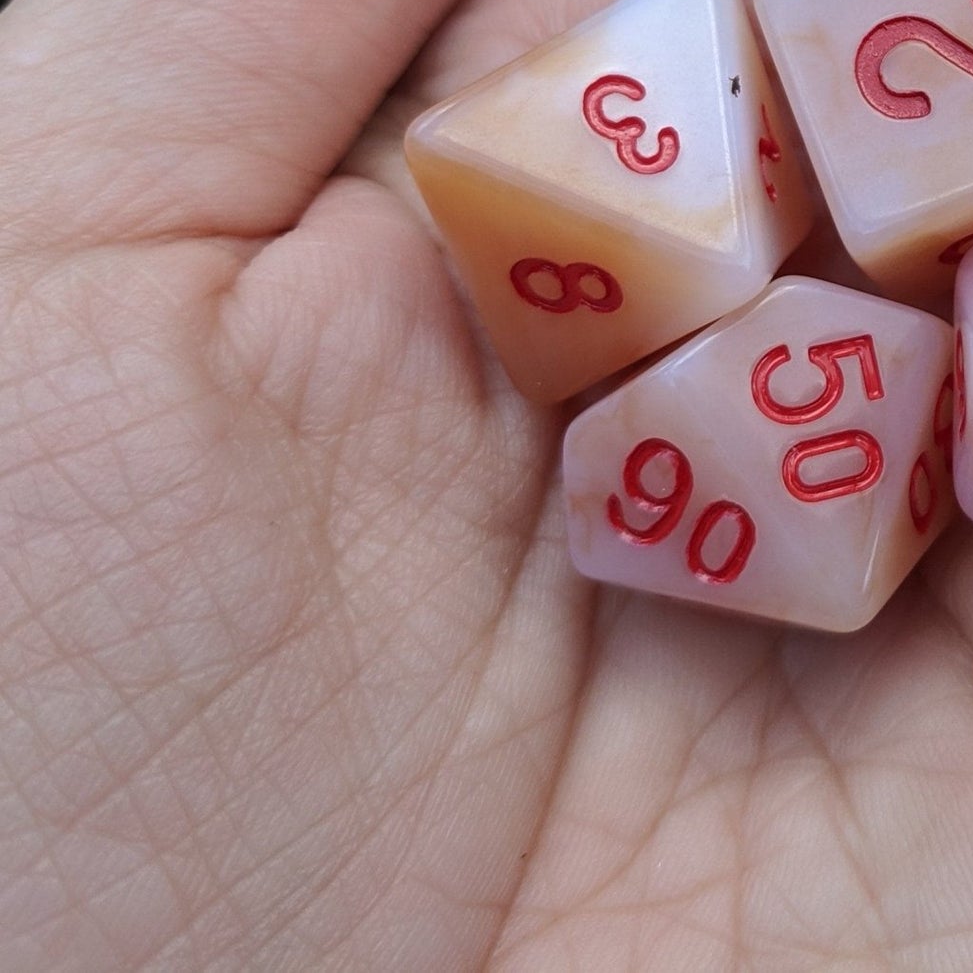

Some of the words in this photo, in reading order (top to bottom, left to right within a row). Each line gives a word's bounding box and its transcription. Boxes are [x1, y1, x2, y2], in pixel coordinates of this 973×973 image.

[582, 74, 680, 175] 3
[509, 257, 624, 314] 8
[750, 333, 886, 504] 50
[605, 437, 757, 587] 90
